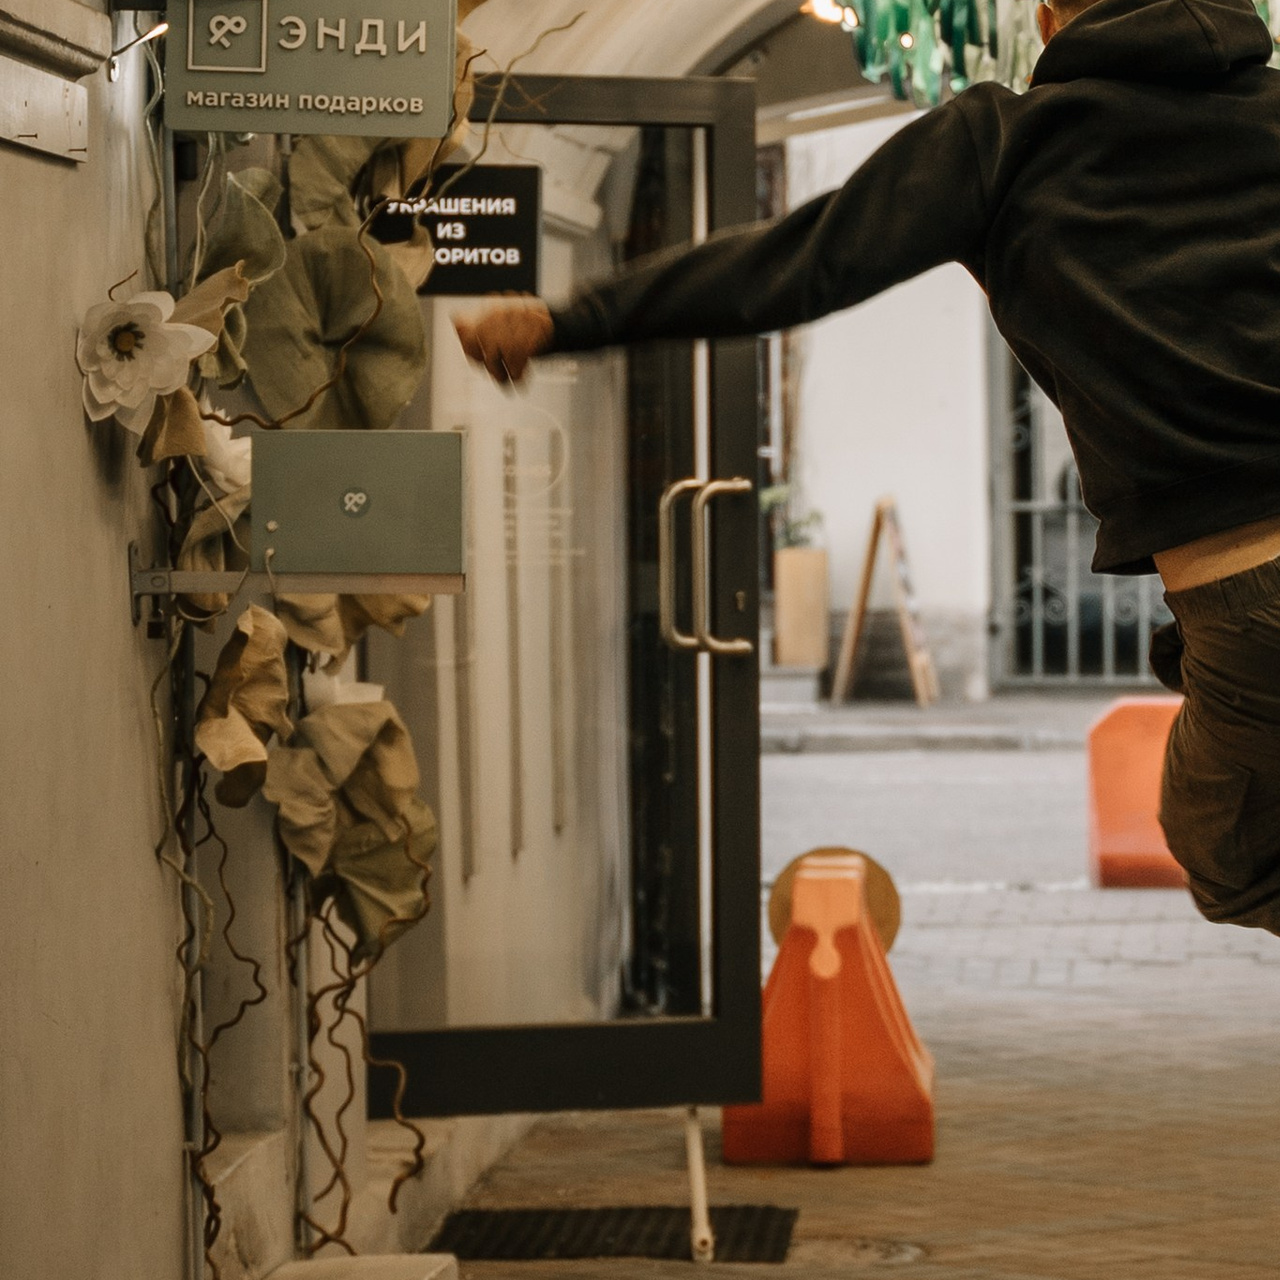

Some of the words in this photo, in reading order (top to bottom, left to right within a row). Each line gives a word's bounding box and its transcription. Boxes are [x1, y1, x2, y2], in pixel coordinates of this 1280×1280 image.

[278, 17, 427, 56] ЭНДИ
[187, 91, 290, 108] магазин
[299, 94, 424, 115] подарков
[436, 221, 466, 239] ИЗ
[431, 247, 520, 265] ОРИТОВ
